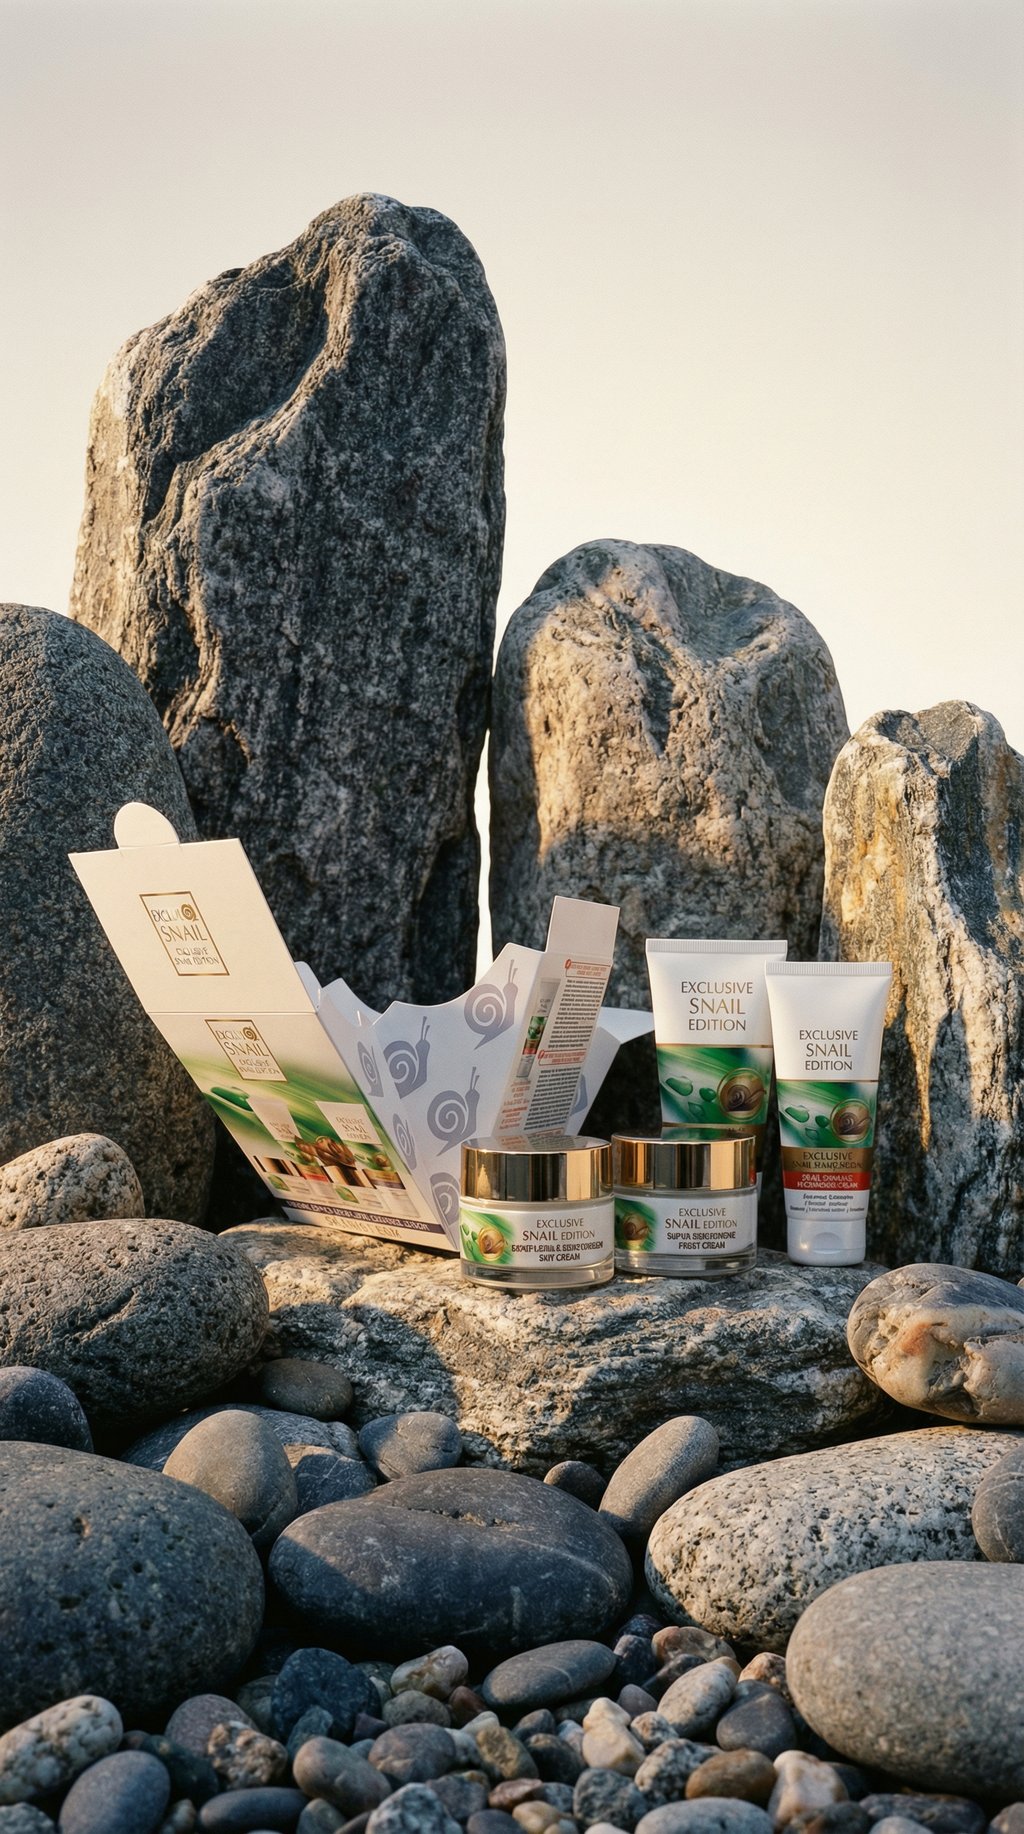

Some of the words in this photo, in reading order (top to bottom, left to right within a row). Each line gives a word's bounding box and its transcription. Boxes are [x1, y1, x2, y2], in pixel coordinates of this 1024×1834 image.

[160, 924, 208, 943] SNAIL
[681, 981, 754, 994] EXCLUSIVE
[689, 997, 746, 1015] SNAIL
[688, 1018, 747, 1031] EDITION
[799, 1029, 859, 1041] EXCLUSIVE
[223, 1041, 270, 1056] SNAIL
[806, 1042, 852, 1058] SNAIL
[805, 1060, 853, 1071] EDITION
[802, 1151, 854, 1161] EXCLUSIVE
[678, 1207, 727, 1217] EXCLUSIVE
[536, 1217, 585, 1229] EXCLUSIVE
[664, 1218, 701, 1230] SNAIL
[703, 1219, 738, 1230] EDITION
[522, 1230, 559, 1242] SNAIL
[560, 1230, 596, 1241] EDITION
